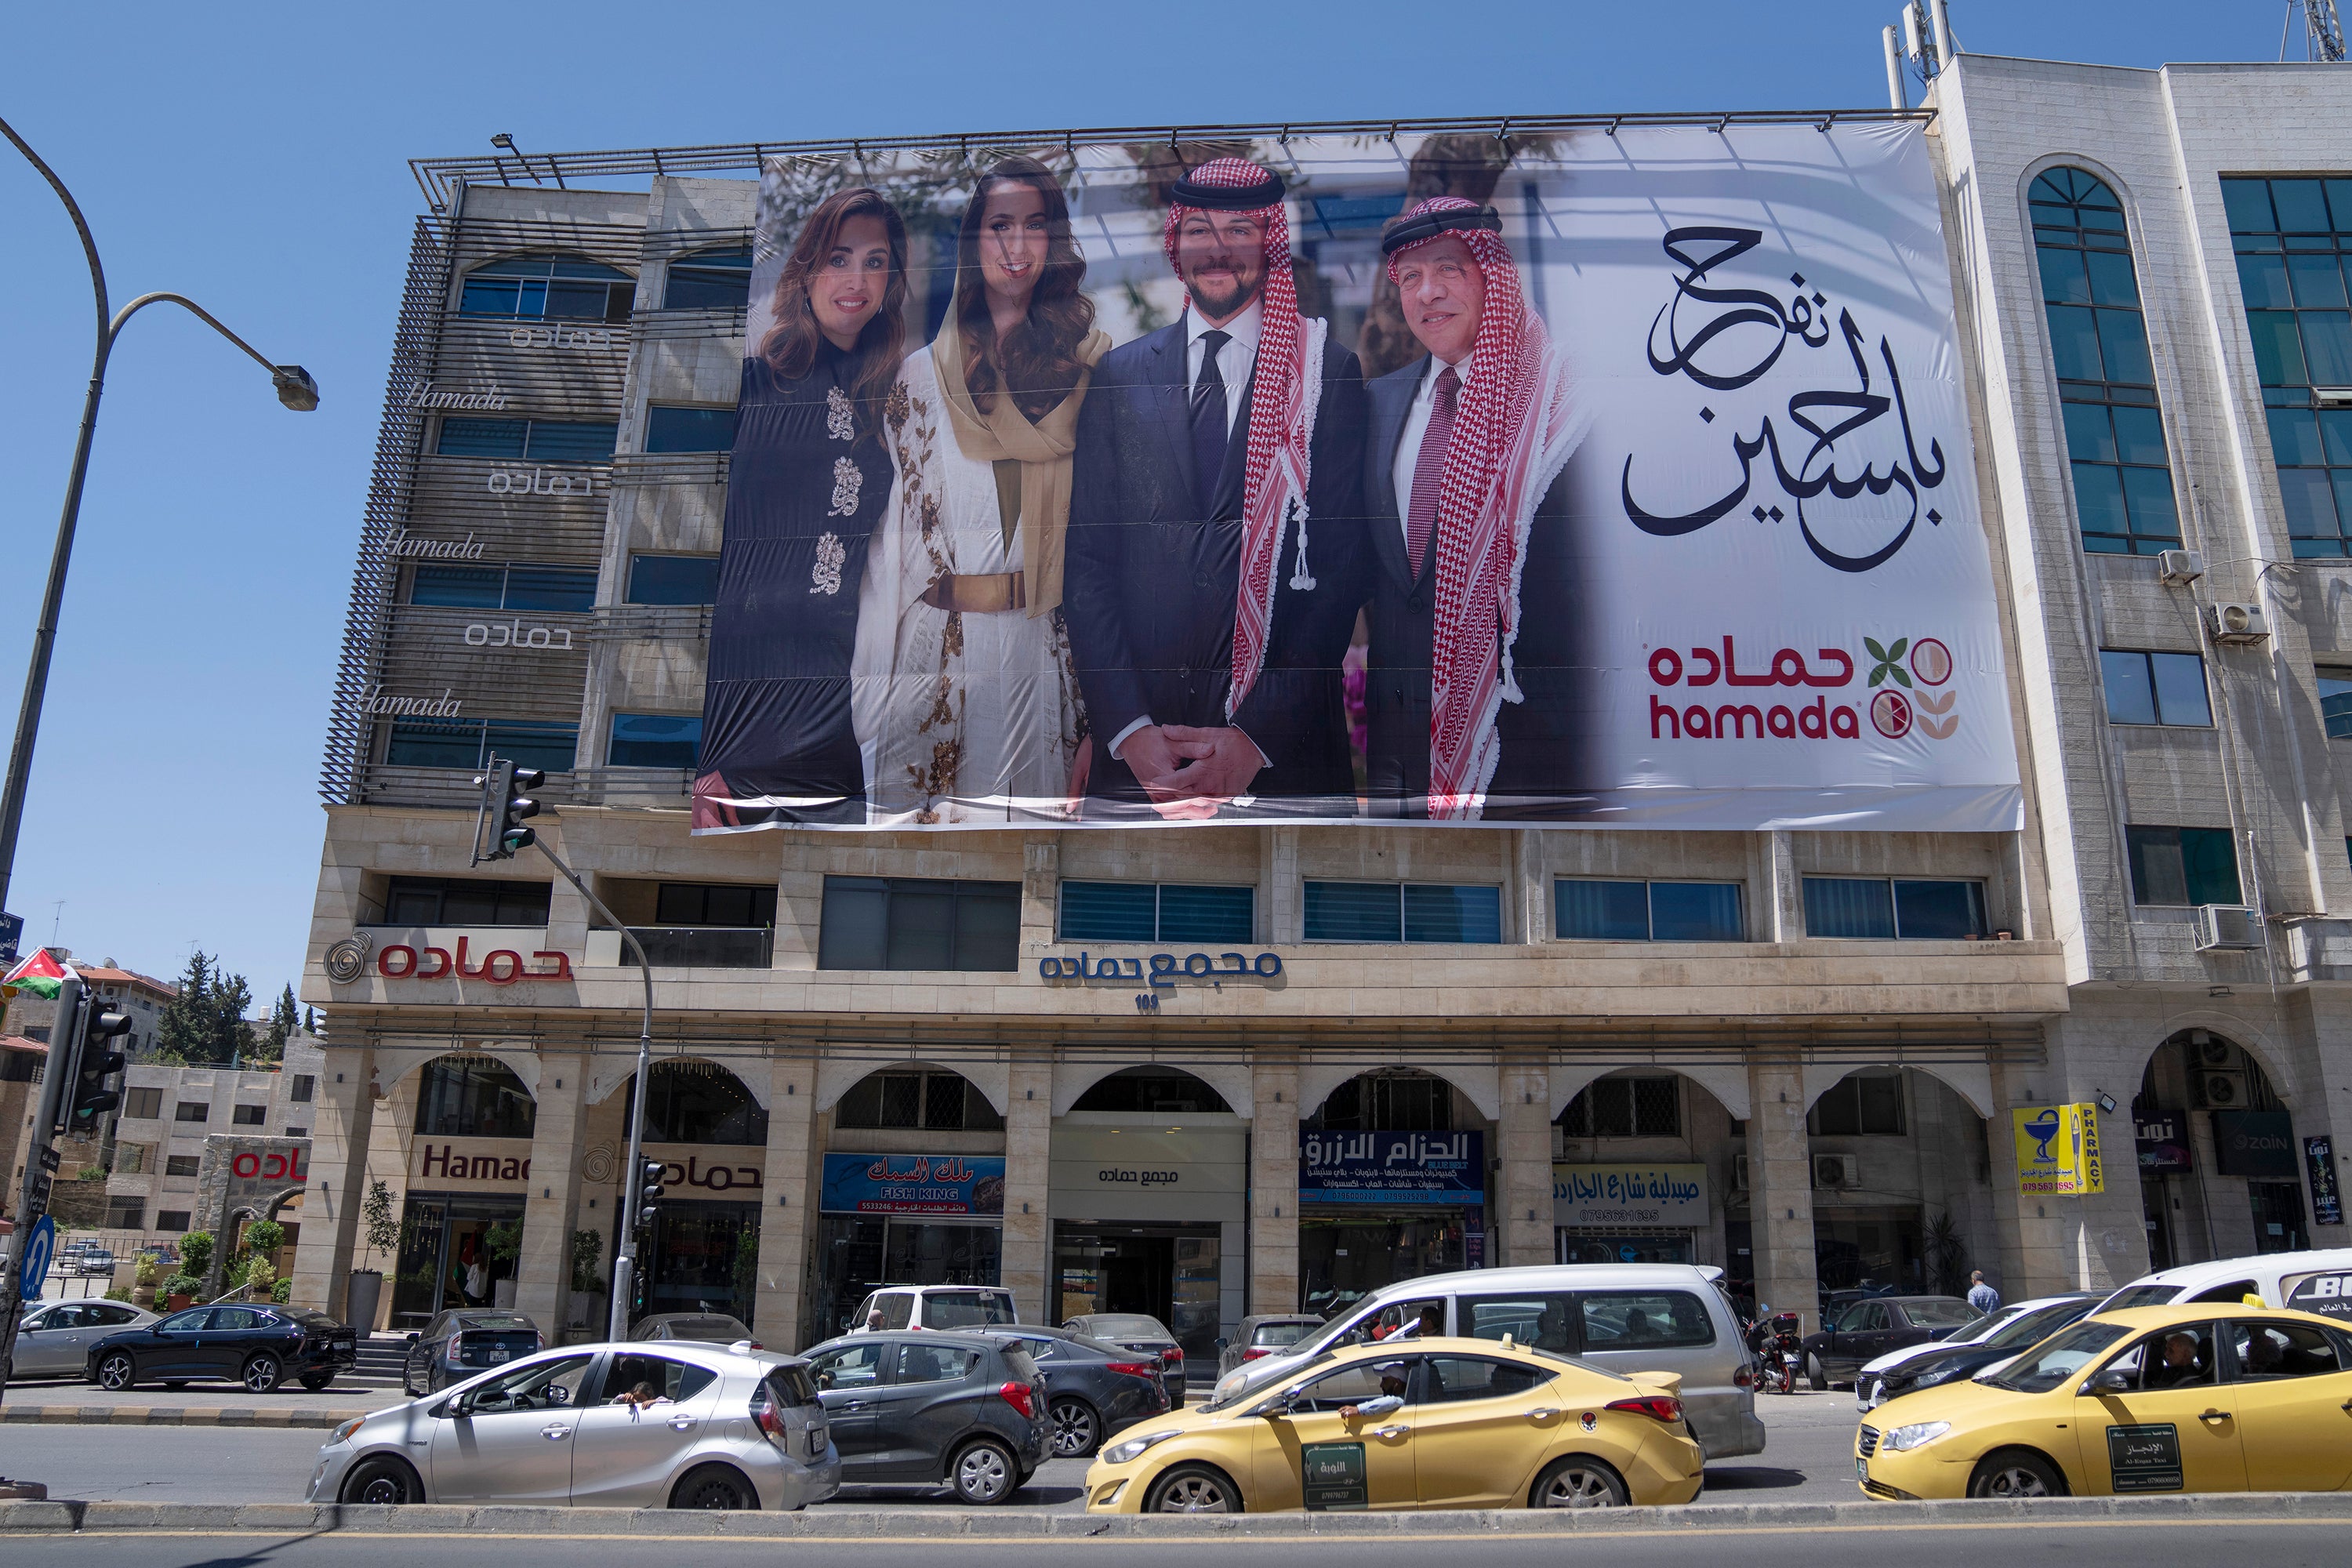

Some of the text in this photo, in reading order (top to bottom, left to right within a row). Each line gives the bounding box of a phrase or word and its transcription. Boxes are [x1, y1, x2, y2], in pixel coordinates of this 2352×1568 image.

[404, 382, 506, 412] Hamada
[1621, 306, 1946, 573] بالحسين
[488, 467, 593, 497] حماده
[378, 528, 485, 561] Hamada
[464, 618, 573, 650] حماده
[1648, 634, 1854, 688] حماده
[353, 684, 463, 719] Hamada
[1649, 695, 1860, 740] hamada
[378, 935, 574, 985] حماده
[1039, 951, 1283, 988] مجمع حماده
[1134, 993, 1159, 1010] 109
[422, 1144, 532, 1181] Hama
[1305, 1134, 1468, 1167] الحزام الازرق
[2083, 1109, 2101, 1187] PHARMACY
[232, 1147, 308, 1181] اده
[662, 1156, 763, 1191] حماد
[867, 1156, 974, 1184] ملك السمك
[1098, 1167, 1178, 1186] مجمع حماده
[1307, 1168, 1333, 1177] ستيشن
[1354, 1168, 1378, 1178] لابتوبات
[1424, 1169, 1457, 1178] كمبيوترات
[1427, 1161, 1468, 1170] BLUE BELT
[2038, 1167, 2053, 1178] شارع
[2053, 1167, 2073, 1178] صيدلية
[880, 1186, 959, 1201] FISH KING
[1552, 1172, 1700, 1205] صيدلية شارع الجاردن
[2023, 1181, 2074, 1192] 079 563 1695
[894, 1202, 921, 1213] الخارجية
[922, 1203, 948, 1213] الطلبات
[1580, 1209, 1660, 1222] 0795631695
[2318, 1302, 2342, 1315] العالم
[2125, 1443, 2164, 1455] الإنجاز
